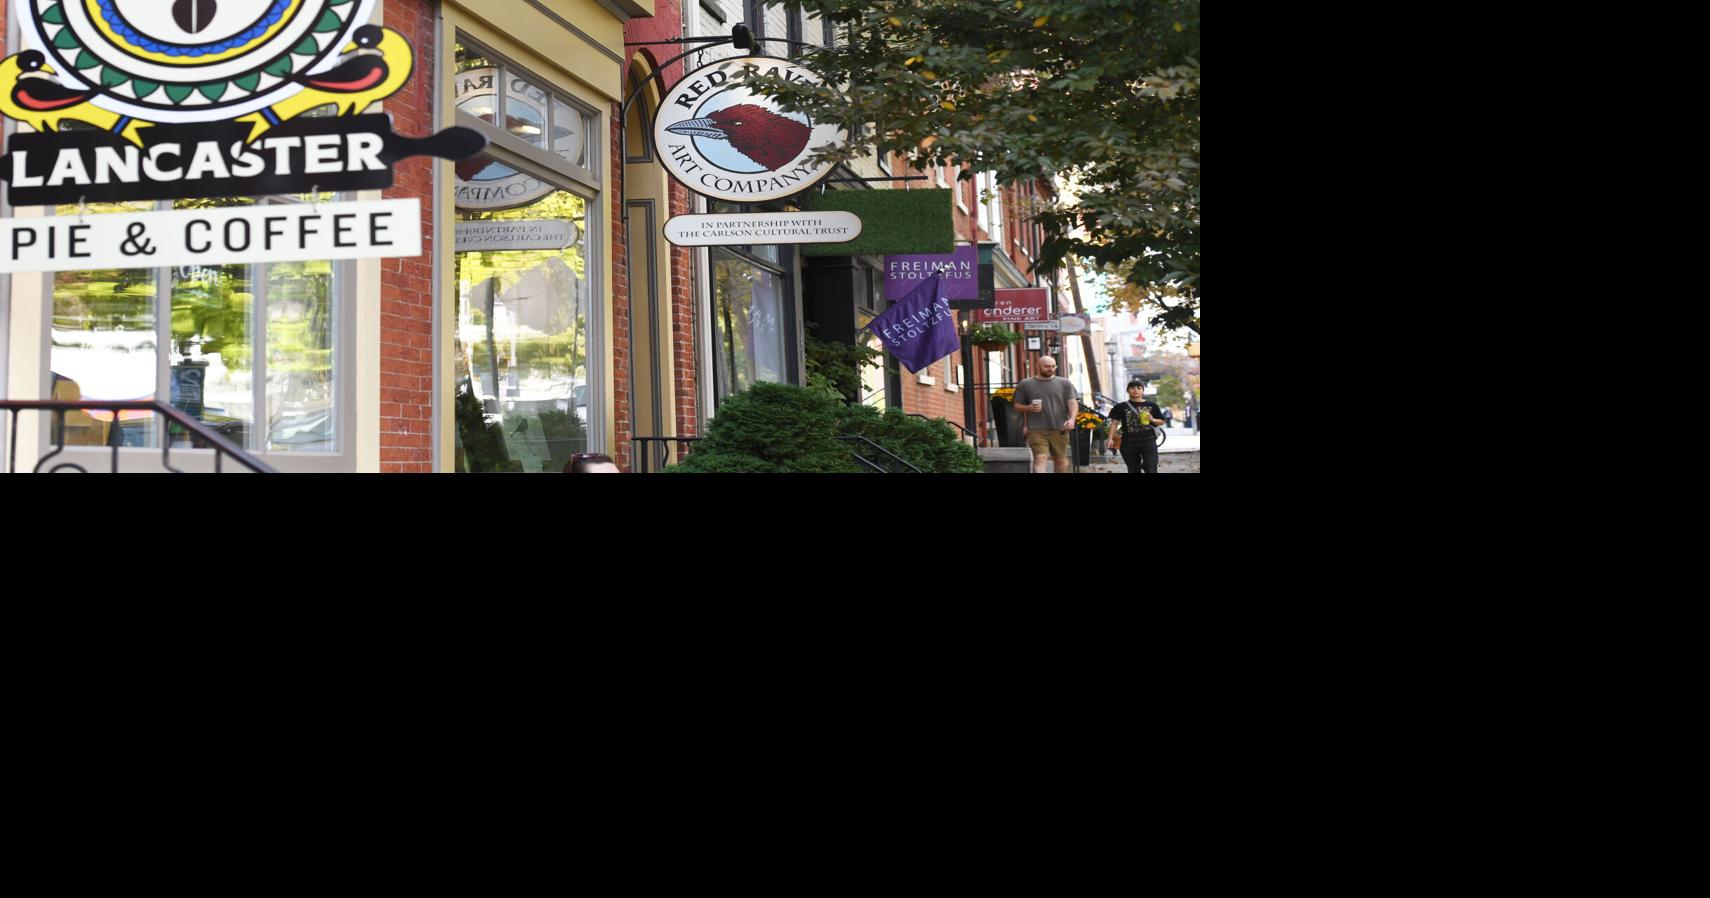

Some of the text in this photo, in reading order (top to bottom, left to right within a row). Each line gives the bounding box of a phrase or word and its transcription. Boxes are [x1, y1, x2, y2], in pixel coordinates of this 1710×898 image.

[674, 70, 727, 110] RED
[11, 132, 386, 188] LANCASTER
[668, 143, 812, 194] ART COMPANY
[11, 211, 393, 260] PIE & COFFEE
[702, 229, 752, 238] CARLSON
[755, 228, 812, 236] CULTURAL
[812, 227, 849, 235] TRUST
[716, 220, 789, 228] PARTNERSHIP
[791, 219, 822, 227] WITH
[890, 261, 970, 271] FREIMAN
[890, 271, 972, 280] STOLTFUS
[892, 308, 952, 347] STOLTZFU
